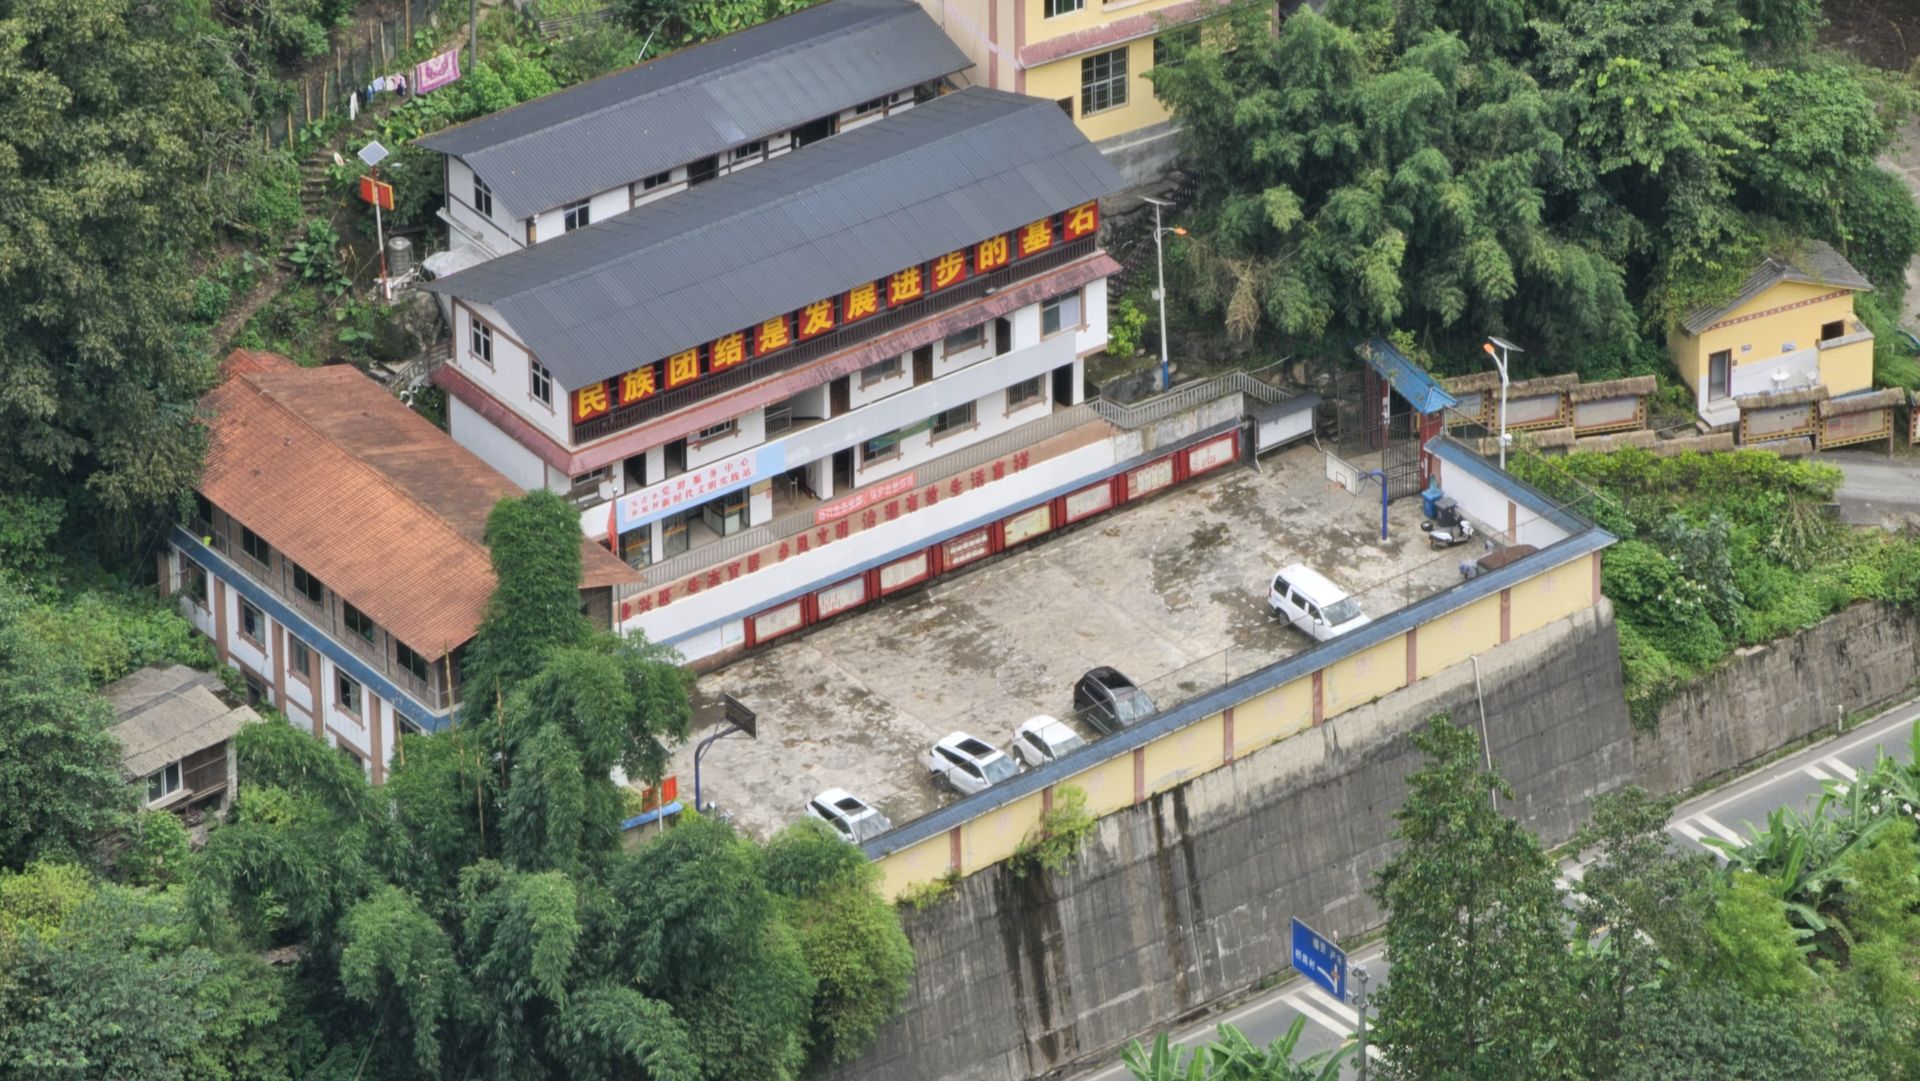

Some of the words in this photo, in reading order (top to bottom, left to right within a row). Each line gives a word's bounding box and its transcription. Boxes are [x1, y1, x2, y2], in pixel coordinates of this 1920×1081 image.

[577, 202, 1096, 419] 民族团结是发展进步的基石
[862, 485, 939, 530] 治理有效
[949, 450, 1030, 497] 生活富裕
